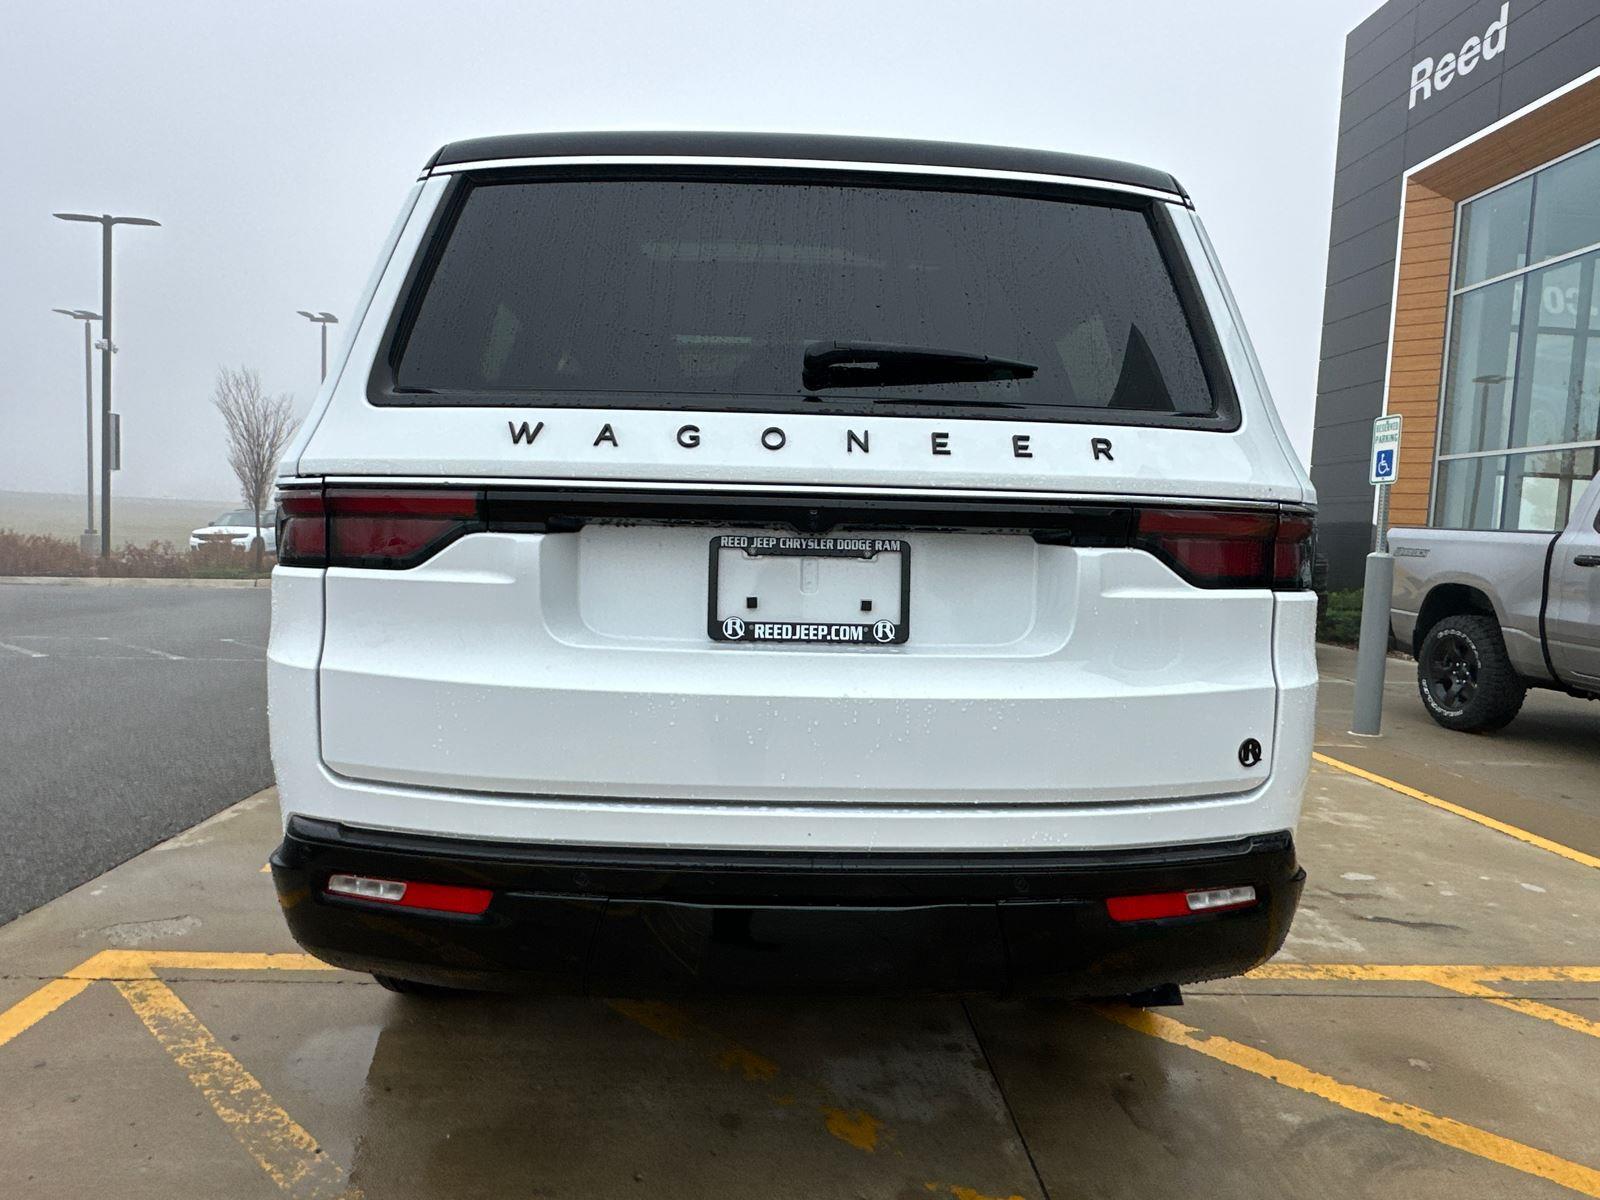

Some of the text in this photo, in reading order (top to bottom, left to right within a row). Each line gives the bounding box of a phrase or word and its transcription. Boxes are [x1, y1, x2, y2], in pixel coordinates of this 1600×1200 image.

[1408, 1, 1510, 110] Reed
[507, 420, 1114, 461] WAGONEER
[1375, 433, 1398, 443] PARKING
[720, 536, 901, 551] REED JEEP CHRYSLER DODGE RAM
[754, 623, 863, 641] REEDJEEP.COM
